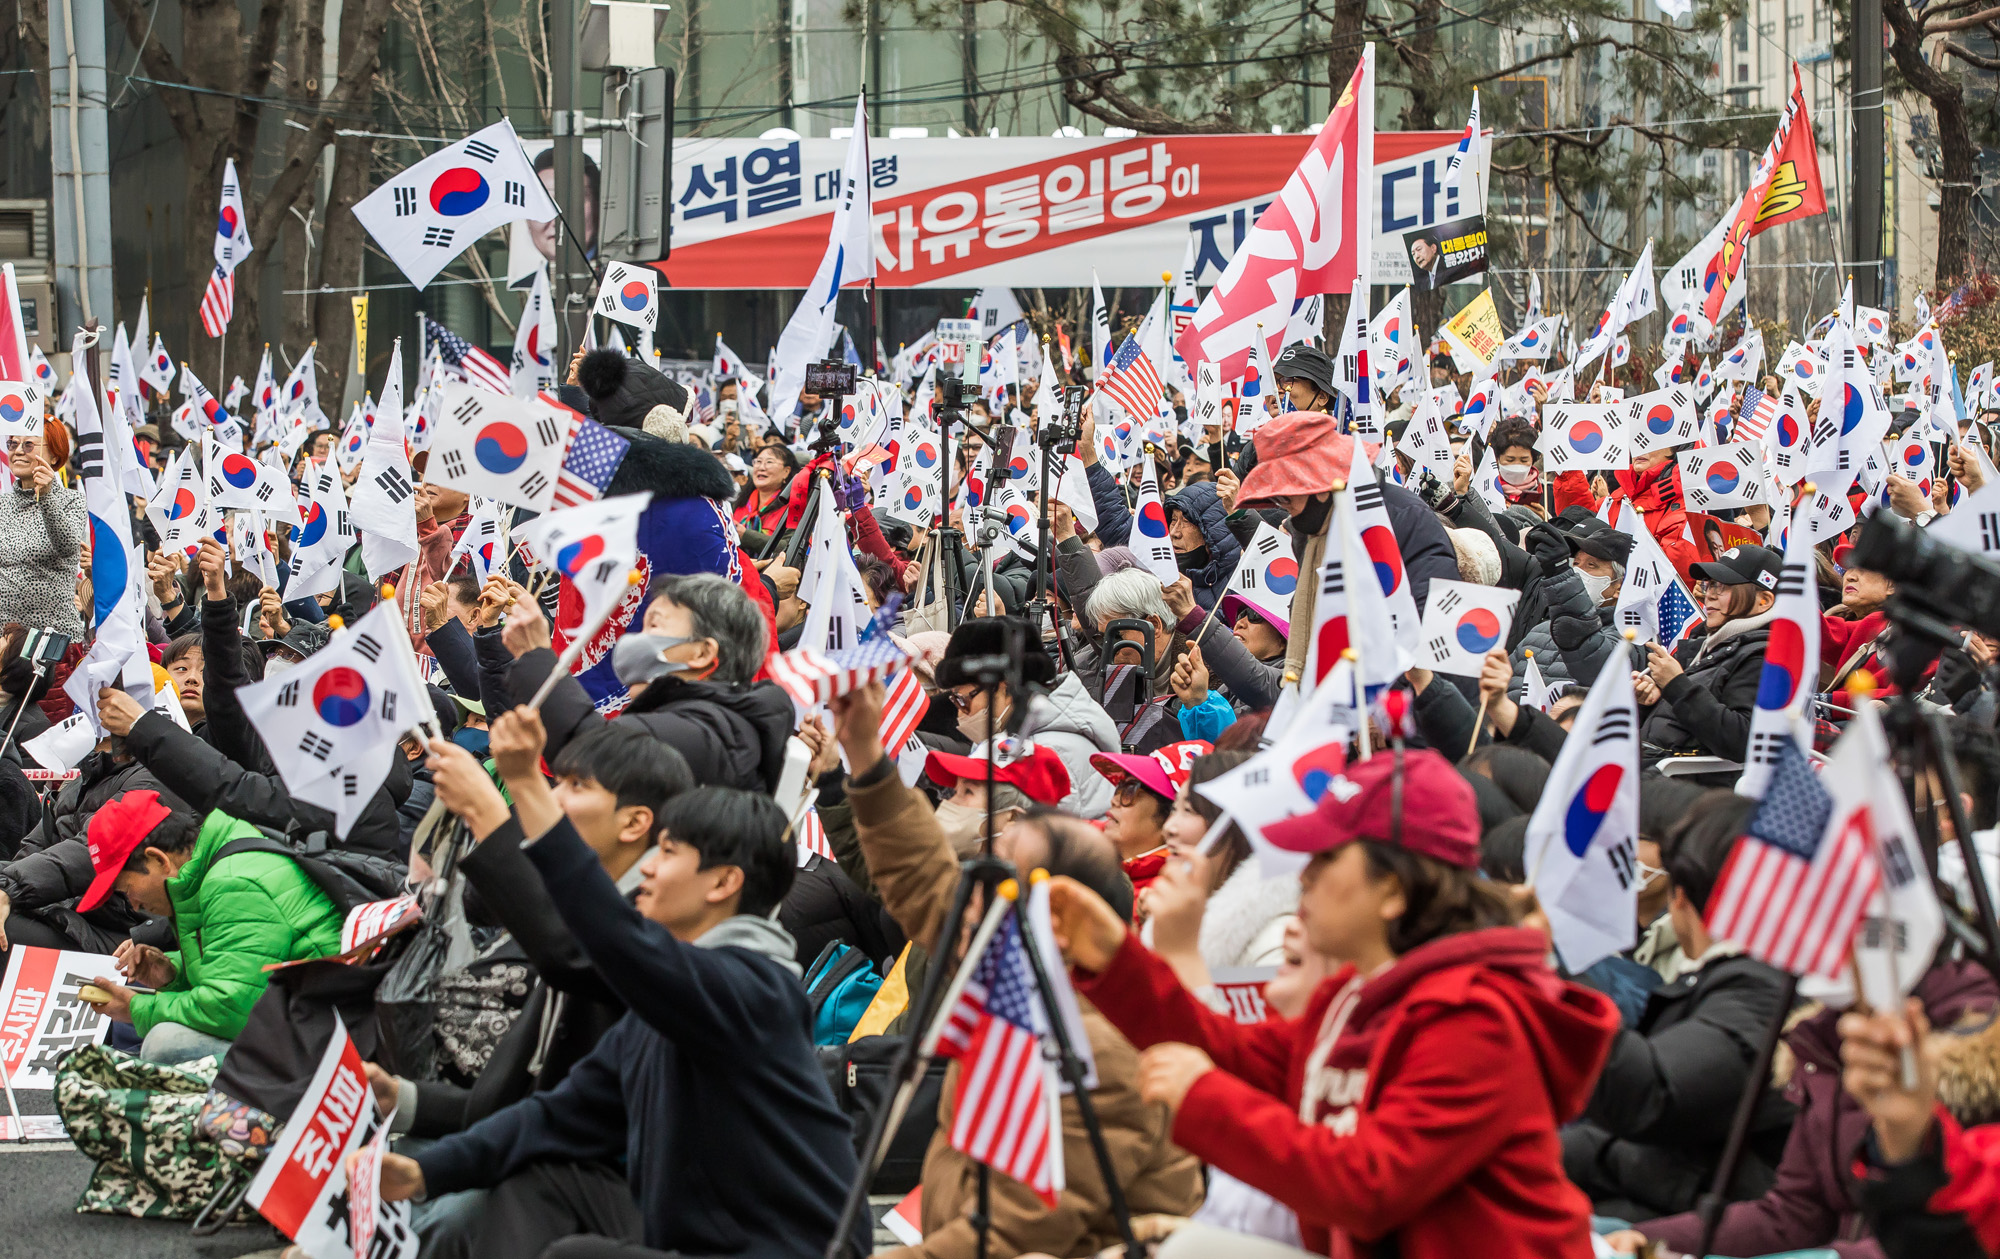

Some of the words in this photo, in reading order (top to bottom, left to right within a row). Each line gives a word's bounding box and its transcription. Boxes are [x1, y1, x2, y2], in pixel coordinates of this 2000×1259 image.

[815, 155, 897, 202] 대령
[1441, 231, 1488, 254] 대통령이
[1461, 322, 1478, 339] 누가
[1469, 330, 1487, 349] 내란
[1478, 337, 1495, 356] 세력
[0, 987, 46, 1062] 주사파
[293, 1064, 365, 1180] 주사파
